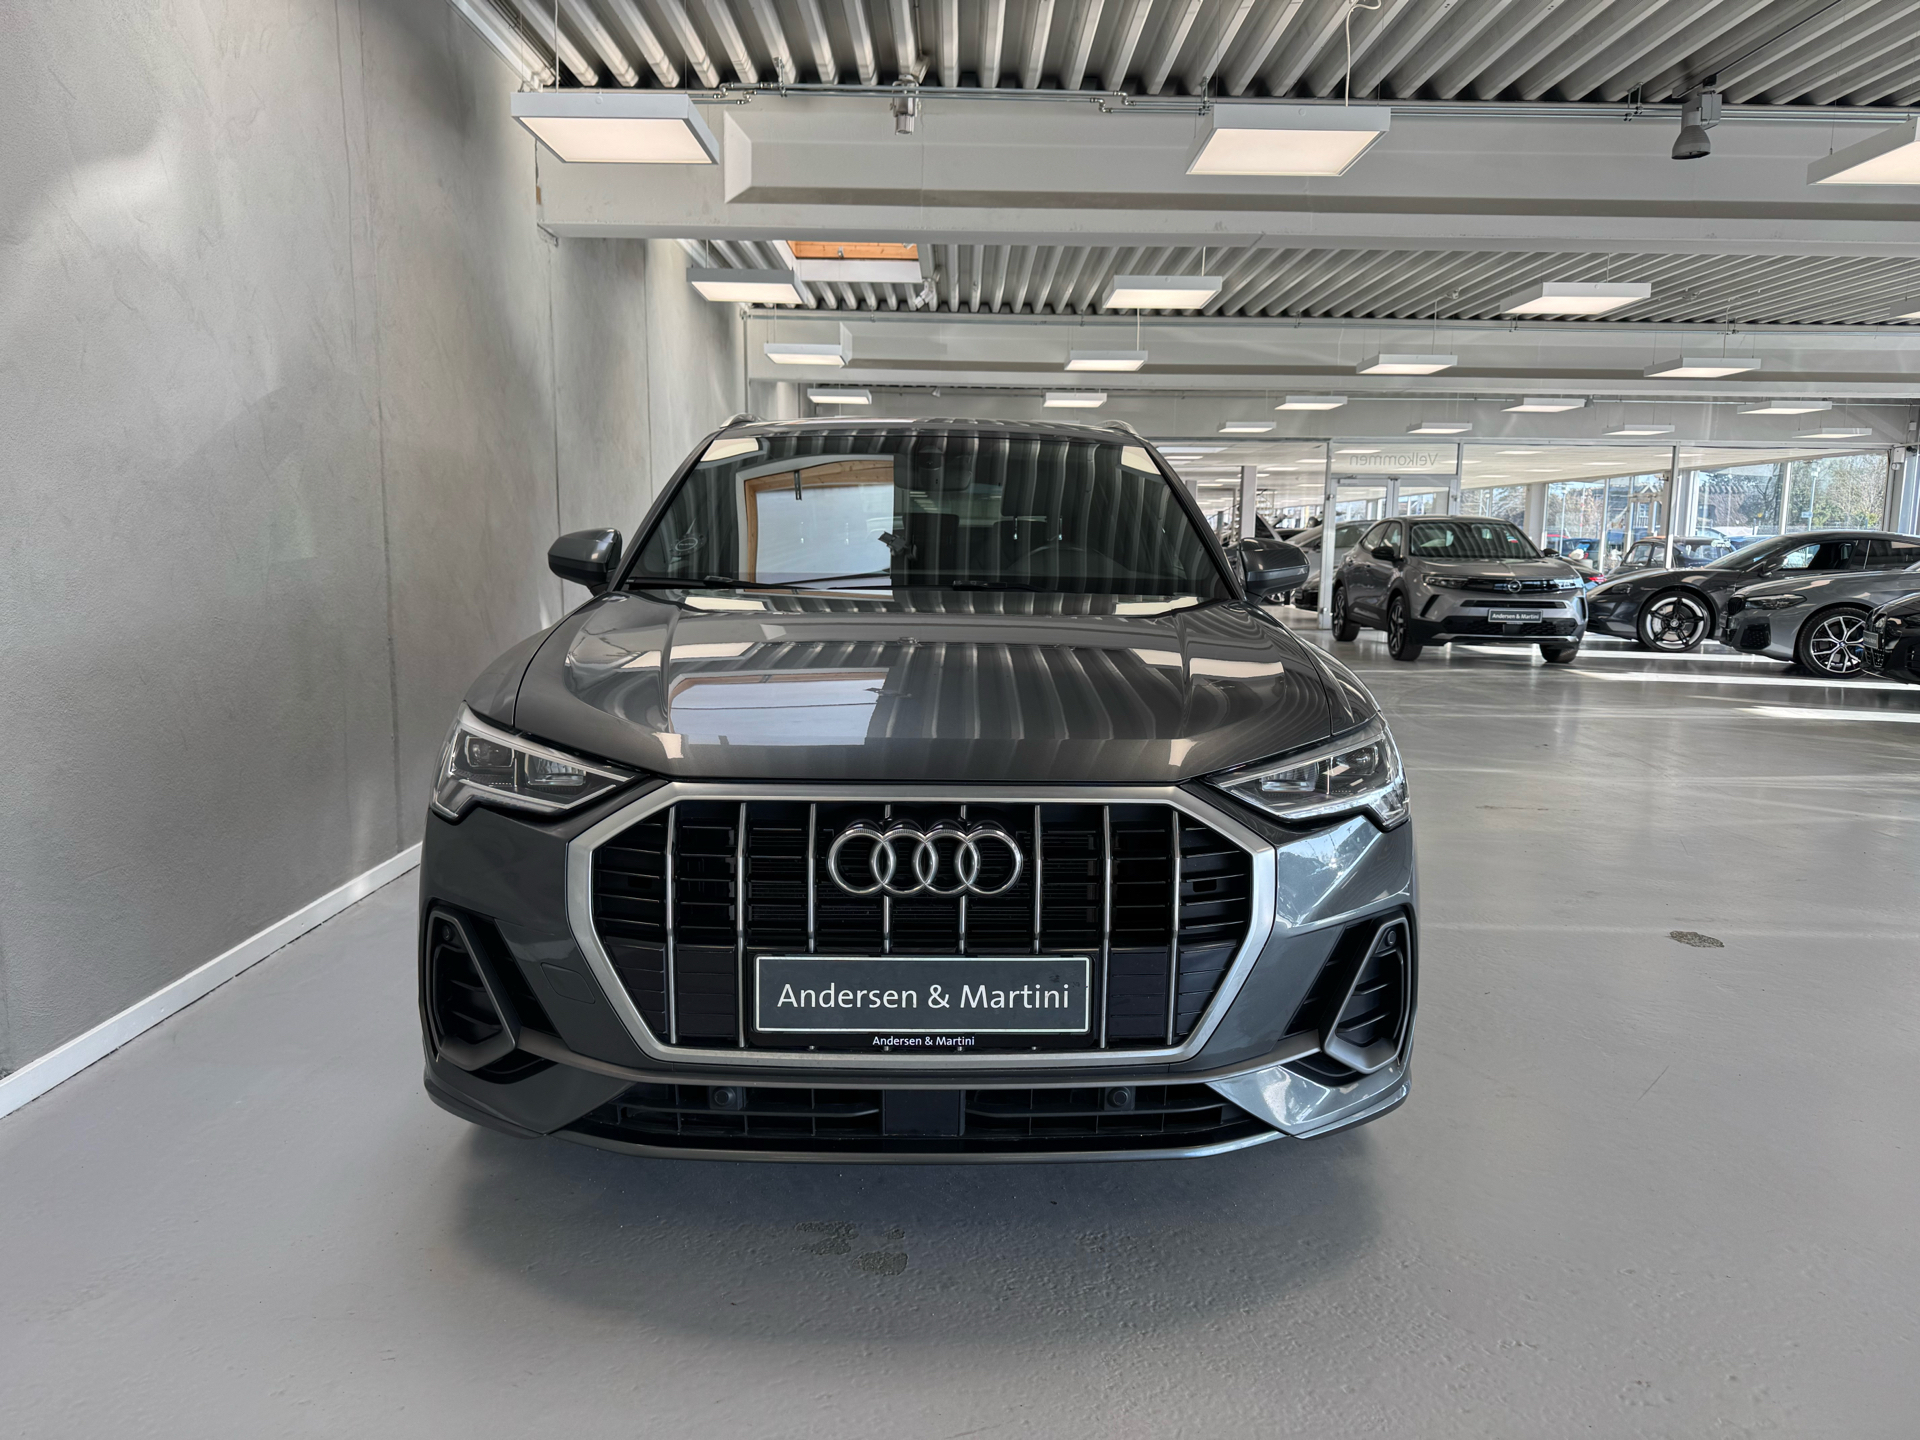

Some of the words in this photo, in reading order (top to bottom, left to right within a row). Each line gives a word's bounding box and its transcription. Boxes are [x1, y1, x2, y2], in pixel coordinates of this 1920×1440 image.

[777, 982, 918, 1008] Andersen
[927, 984, 950, 1008] &
[959, 983, 1069, 1008] Martini
[872, 1035, 922, 1046] Andersen
[924, 1036, 934, 1046] &
[936, 1035, 975, 1046] Martini
